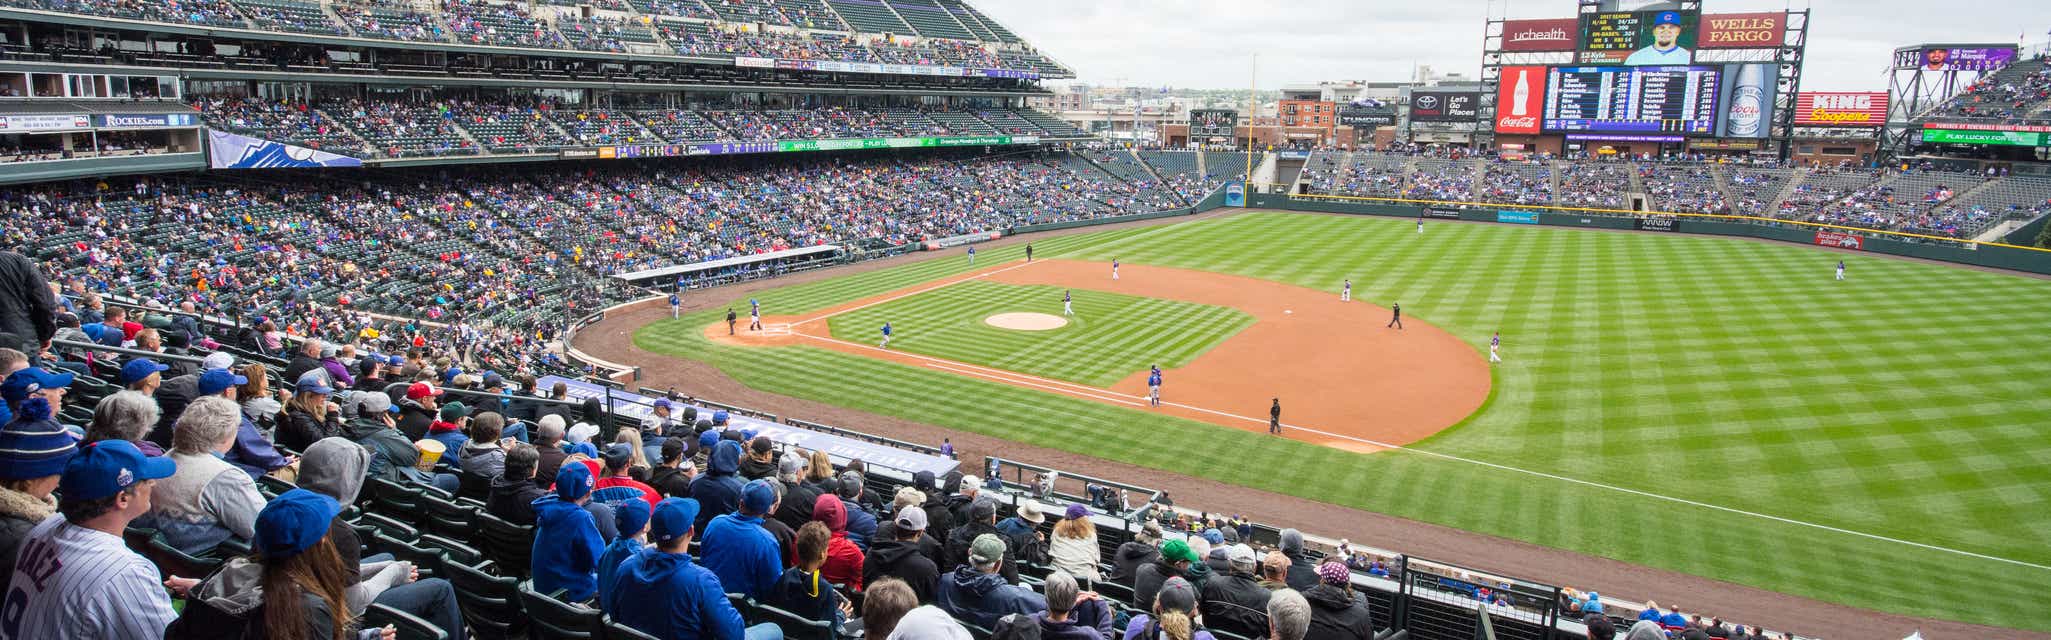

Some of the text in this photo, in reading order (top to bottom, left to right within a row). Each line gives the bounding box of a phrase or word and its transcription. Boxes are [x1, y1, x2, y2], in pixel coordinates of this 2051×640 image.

[1711, 18, 1775, 30] WELLS
[1514, 28, 1566, 40] uchealth
[1709, 30, 1773, 42] FARGO
[1812, 95, 1872, 110] KING
[1808, 108, 1873, 125] Soopers
